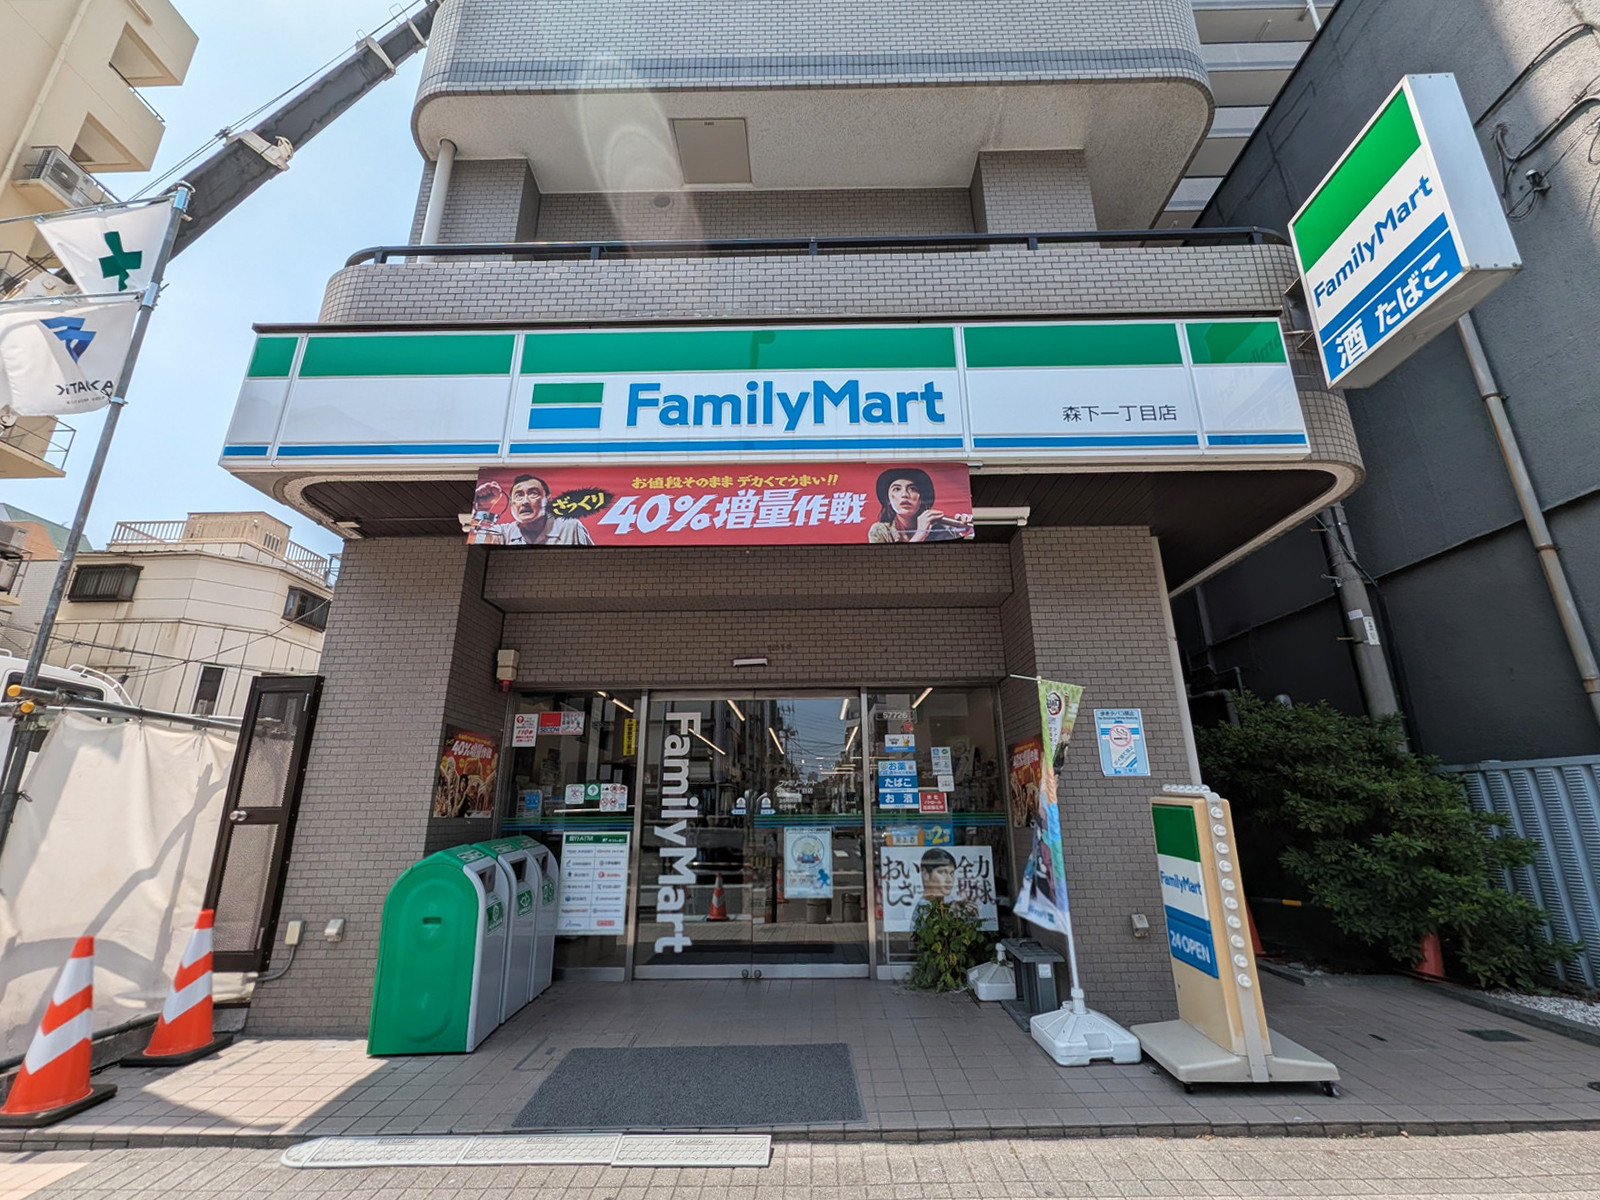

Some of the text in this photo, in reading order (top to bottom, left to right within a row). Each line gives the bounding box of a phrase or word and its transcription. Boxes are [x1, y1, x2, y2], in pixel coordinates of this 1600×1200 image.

[1312, 174, 1433, 308] FamilyMart
[1335, 252, 1449, 370] 酒 たばこ
[625, 378, 946, 432] FamilyMart
[1062, 404, 1178, 423] 森下一丁目店
[631, 475, 734, 490] お値段そのまま
[552, 491, 606, 516] ざっくり
[597, 489, 867, 535] 40%増量作戦
[885, 778, 912, 787] たばこ
[653, 711, 702, 954] FamilyMart
[1159, 870, 1203, 896] FamilyMart
